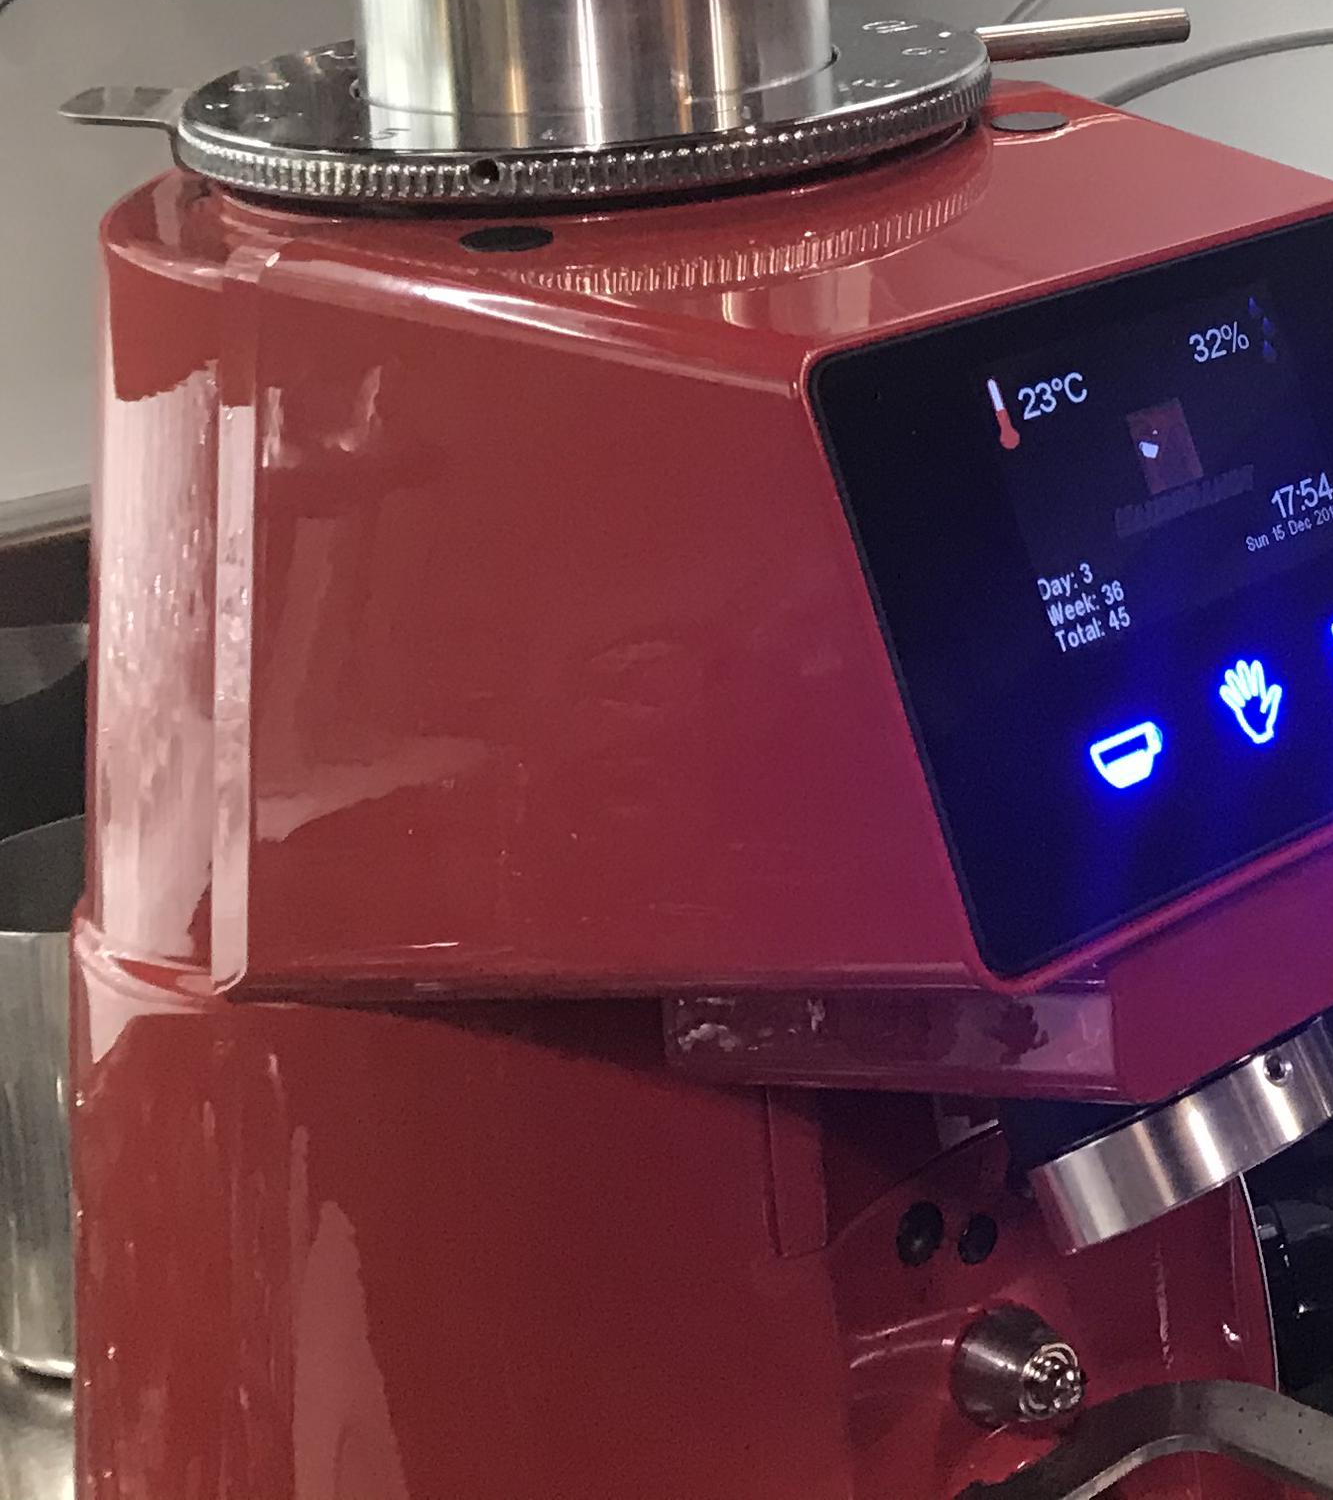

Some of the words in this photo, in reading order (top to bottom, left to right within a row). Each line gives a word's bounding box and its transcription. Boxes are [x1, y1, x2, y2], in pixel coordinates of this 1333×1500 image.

[1188, 321, 1250, 363] 32%
[1018, 372, 1088, 420] 23°C
[1271, 472, 1333, 519] 17:54
[1246, 533, 1270, 552] Sun
[1272, 525, 1286, 542] 15
[1289, 517, 1313, 536] Dec
[1037, 567, 1080, 601] Day:
[1081, 563, 1094, 584] 3
[1047, 593, 1100, 628] Week:
[1101, 580, 1125, 605] 36
[1055, 618, 1106, 652] Total:
[1108, 606, 1131, 631] 45
